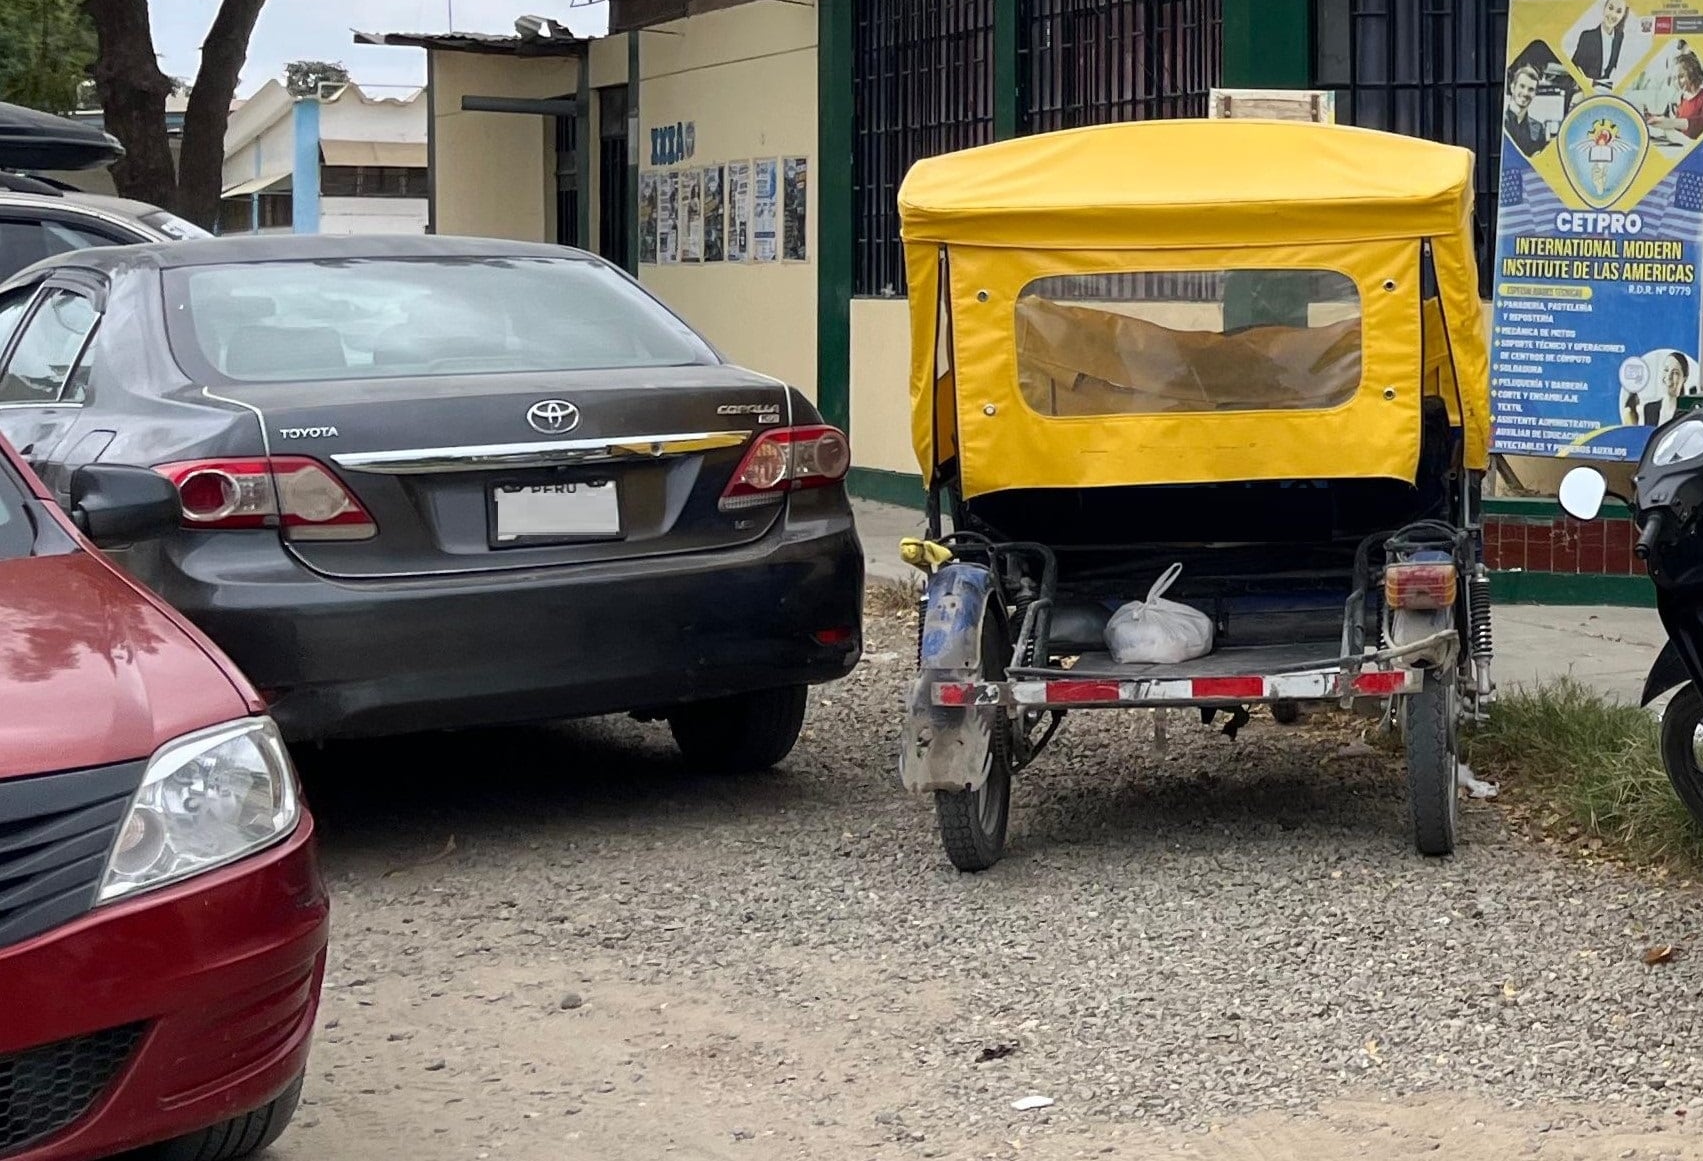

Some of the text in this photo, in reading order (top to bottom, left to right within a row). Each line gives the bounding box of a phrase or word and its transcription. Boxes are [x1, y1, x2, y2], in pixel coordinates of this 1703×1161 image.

[1556, 213, 1642, 235] CETPRO
[1515, 237, 1682, 260] INTERNATIONAL MODERN
[1503, 258, 1694, 282] INSTITUTE DE LAS AMERICAS
[1669, 286, 1692, 296] 0779
[279, 426, 339, 439] TOYOTA
